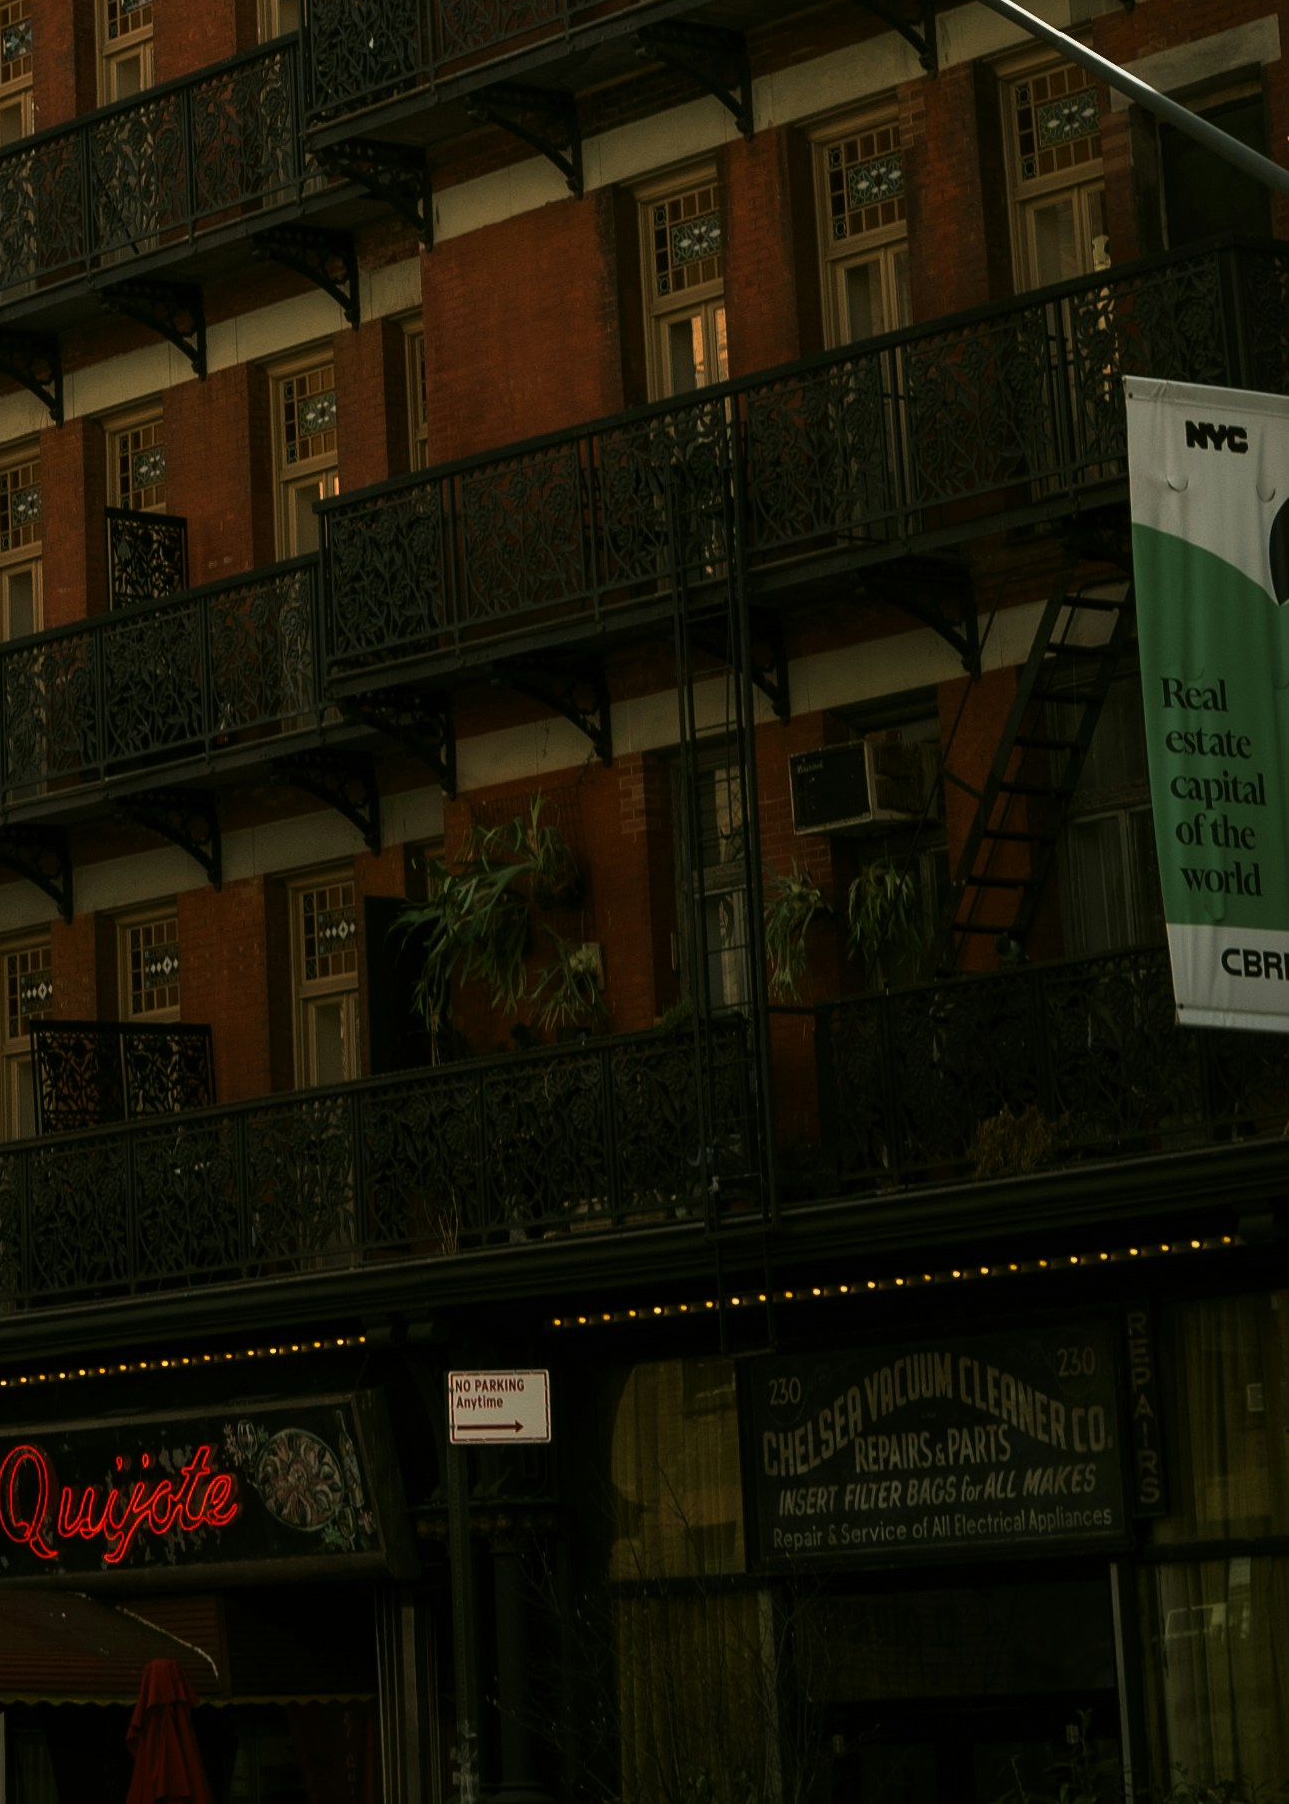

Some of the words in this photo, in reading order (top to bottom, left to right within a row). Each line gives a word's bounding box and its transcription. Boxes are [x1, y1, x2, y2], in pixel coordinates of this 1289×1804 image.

[1185, 420, 1249, 454] NYC
[1161, 677, 1229, 712] Real
[1165, 726, 1253, 759] estate
[1170, 770, 1267, 809] capital
[1175, 813, 1207, 846] of
[1210, 815, 1256, 850] the
[1180, 861, 1264, 897] world
[1057, 1346, 1096, 1378] 230
[455, 1379, 471, 1392] NO
[475, 1379, 524, 1392] PARKING
[456, 1395, 503, 1411] Anytime
[768, 1376, 802, 1406] 230
[762, 1384, 863, 1478] CHELSEA
[863, 1351, 953, 1423] VACUUM
[958, 1355, 1067, 1450] CLEANER
[1071, 1404, 1114, 1453] CO.
[1126, 1310, 1161, 1504] REPAIRS
[854, 1431, 933, 1473] REPAIRS
[935, 1443, 947, 1466] &
[947, 1423, 1012, 1466] PARTS
[778, 1484, 838, 1517] INSERT
[845, 1480, 902, 1511] FILTER
[906, 1474, 957, 1506] BAGS
[960, 1475, 983, 1502] for
[984, 1469, 1017, 1500] ALL
[1022, 1462, 1097, 1497] MAKES
[773, 1526, 823, 1553] Repair
[828, 1523, 838, 1546] &
[840, 1519, 907, 1545] Service
[912, 1515, 929, 1539] of
[932, 1513, 951, 1537] All
[954, 1509, 1026, 1535] Electrical
[1028, 1506, 1113, 1535] Appliances
